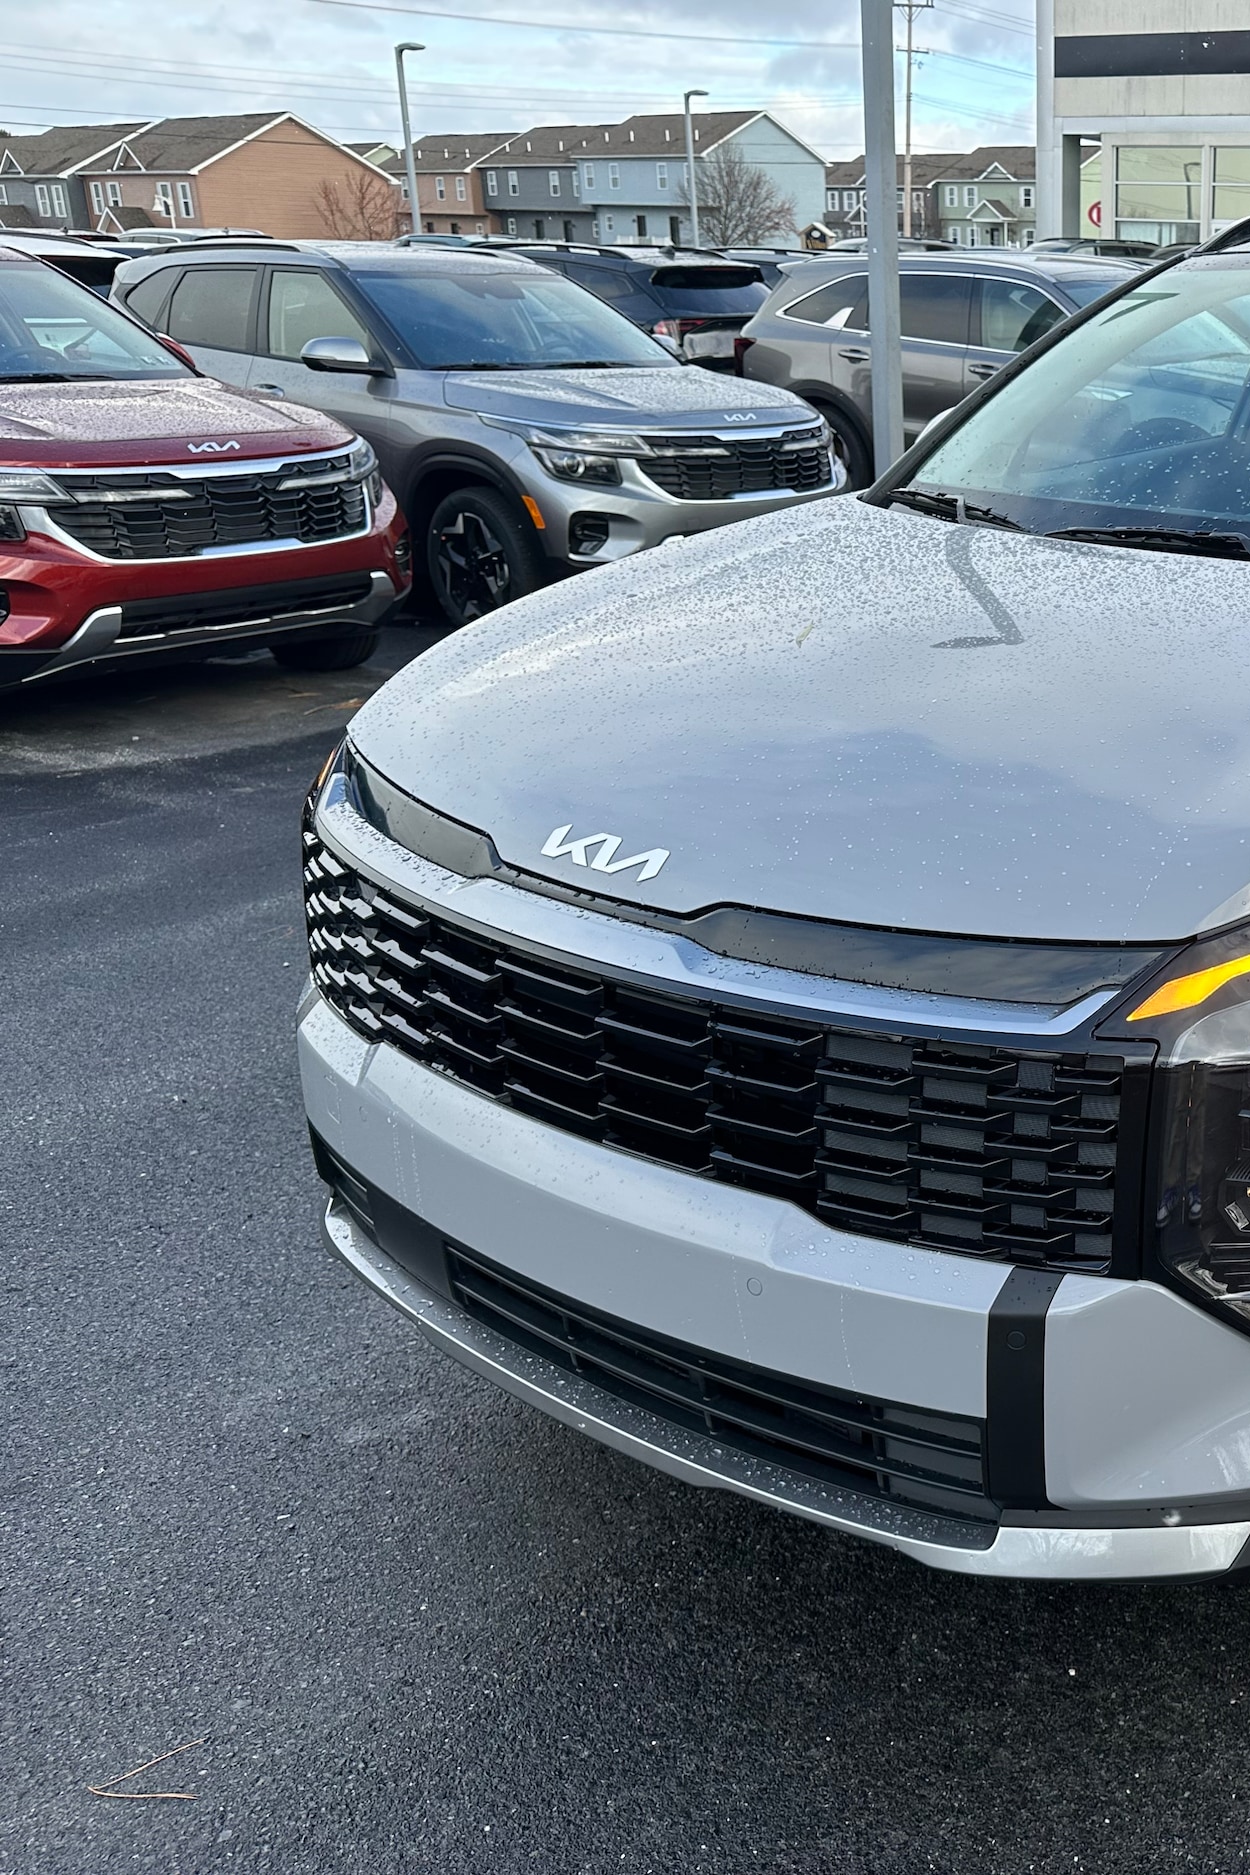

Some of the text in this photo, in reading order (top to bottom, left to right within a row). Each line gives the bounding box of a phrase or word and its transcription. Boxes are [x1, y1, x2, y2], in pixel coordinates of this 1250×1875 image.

[723, 412, 757, 422] KIA
[187, 440, 241, 454] KIA
[541, 824, 671, 882] KIA
